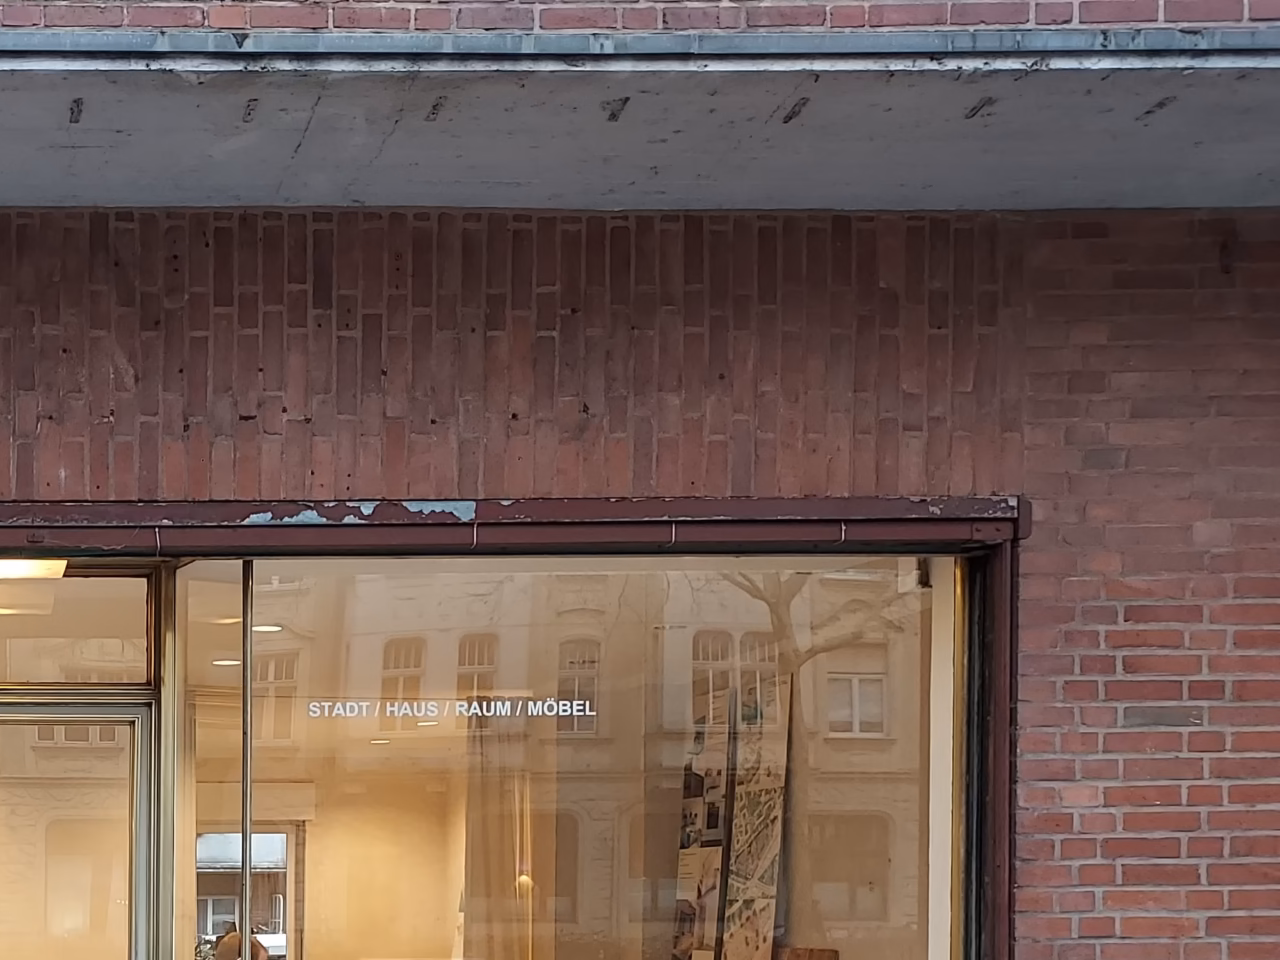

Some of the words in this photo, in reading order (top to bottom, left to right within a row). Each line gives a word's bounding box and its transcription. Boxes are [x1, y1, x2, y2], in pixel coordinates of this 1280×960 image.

[308, 701, 370, 717] STADT
[386, 701, 439, 717] HAUS
[455, 700, 511, 717] RAUM
[527, 697, 597, 716] MÖBEL
